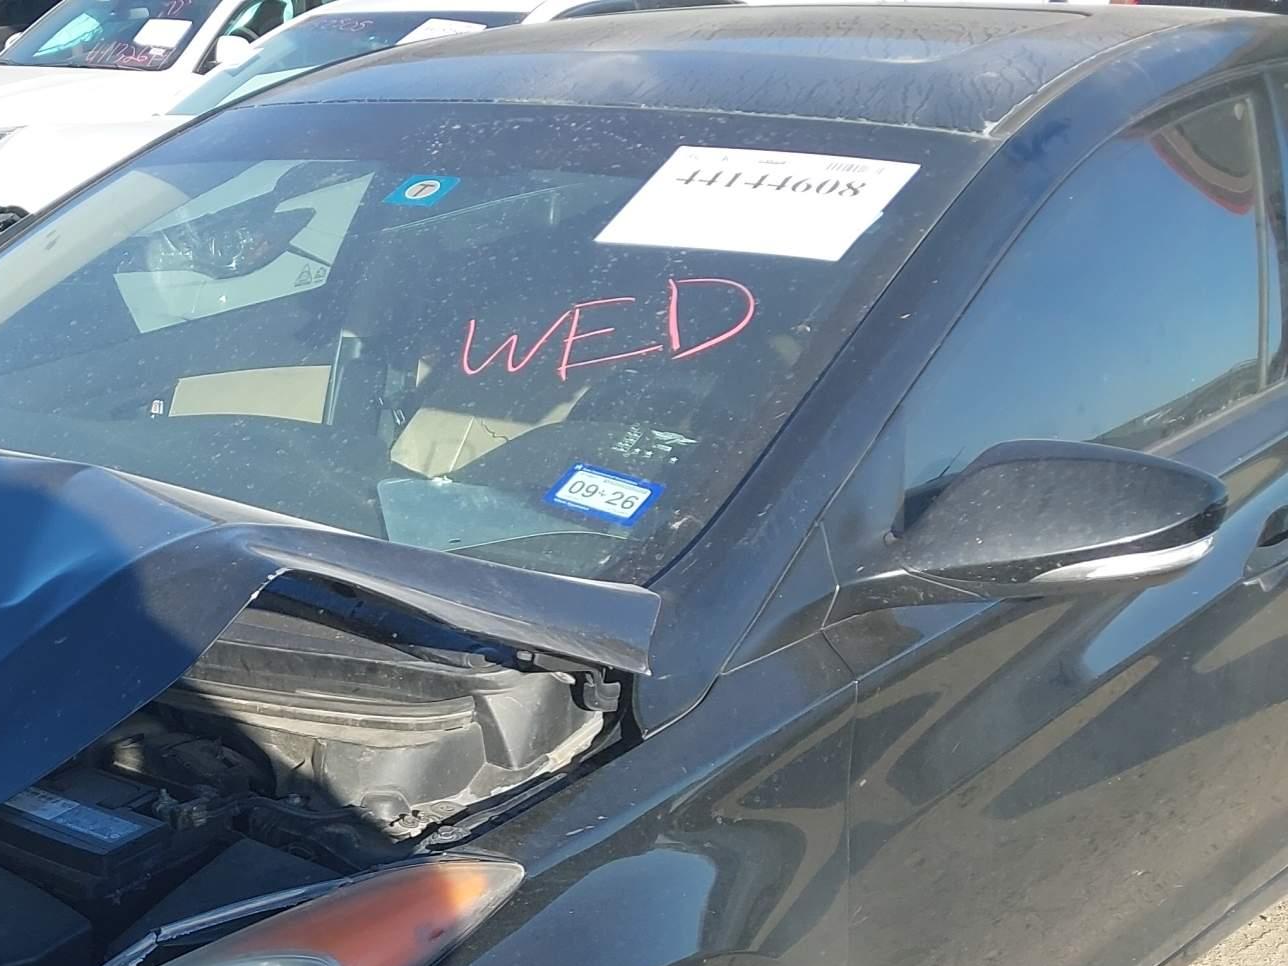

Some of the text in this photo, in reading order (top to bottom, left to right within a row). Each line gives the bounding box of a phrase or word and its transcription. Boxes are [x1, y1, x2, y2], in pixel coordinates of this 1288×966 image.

[675, 168, 867, 198] 44144608
[463, 278, 755, 381] WED
[567, 480, 600, 499] 09
[605, 490, 640, 510] 26
